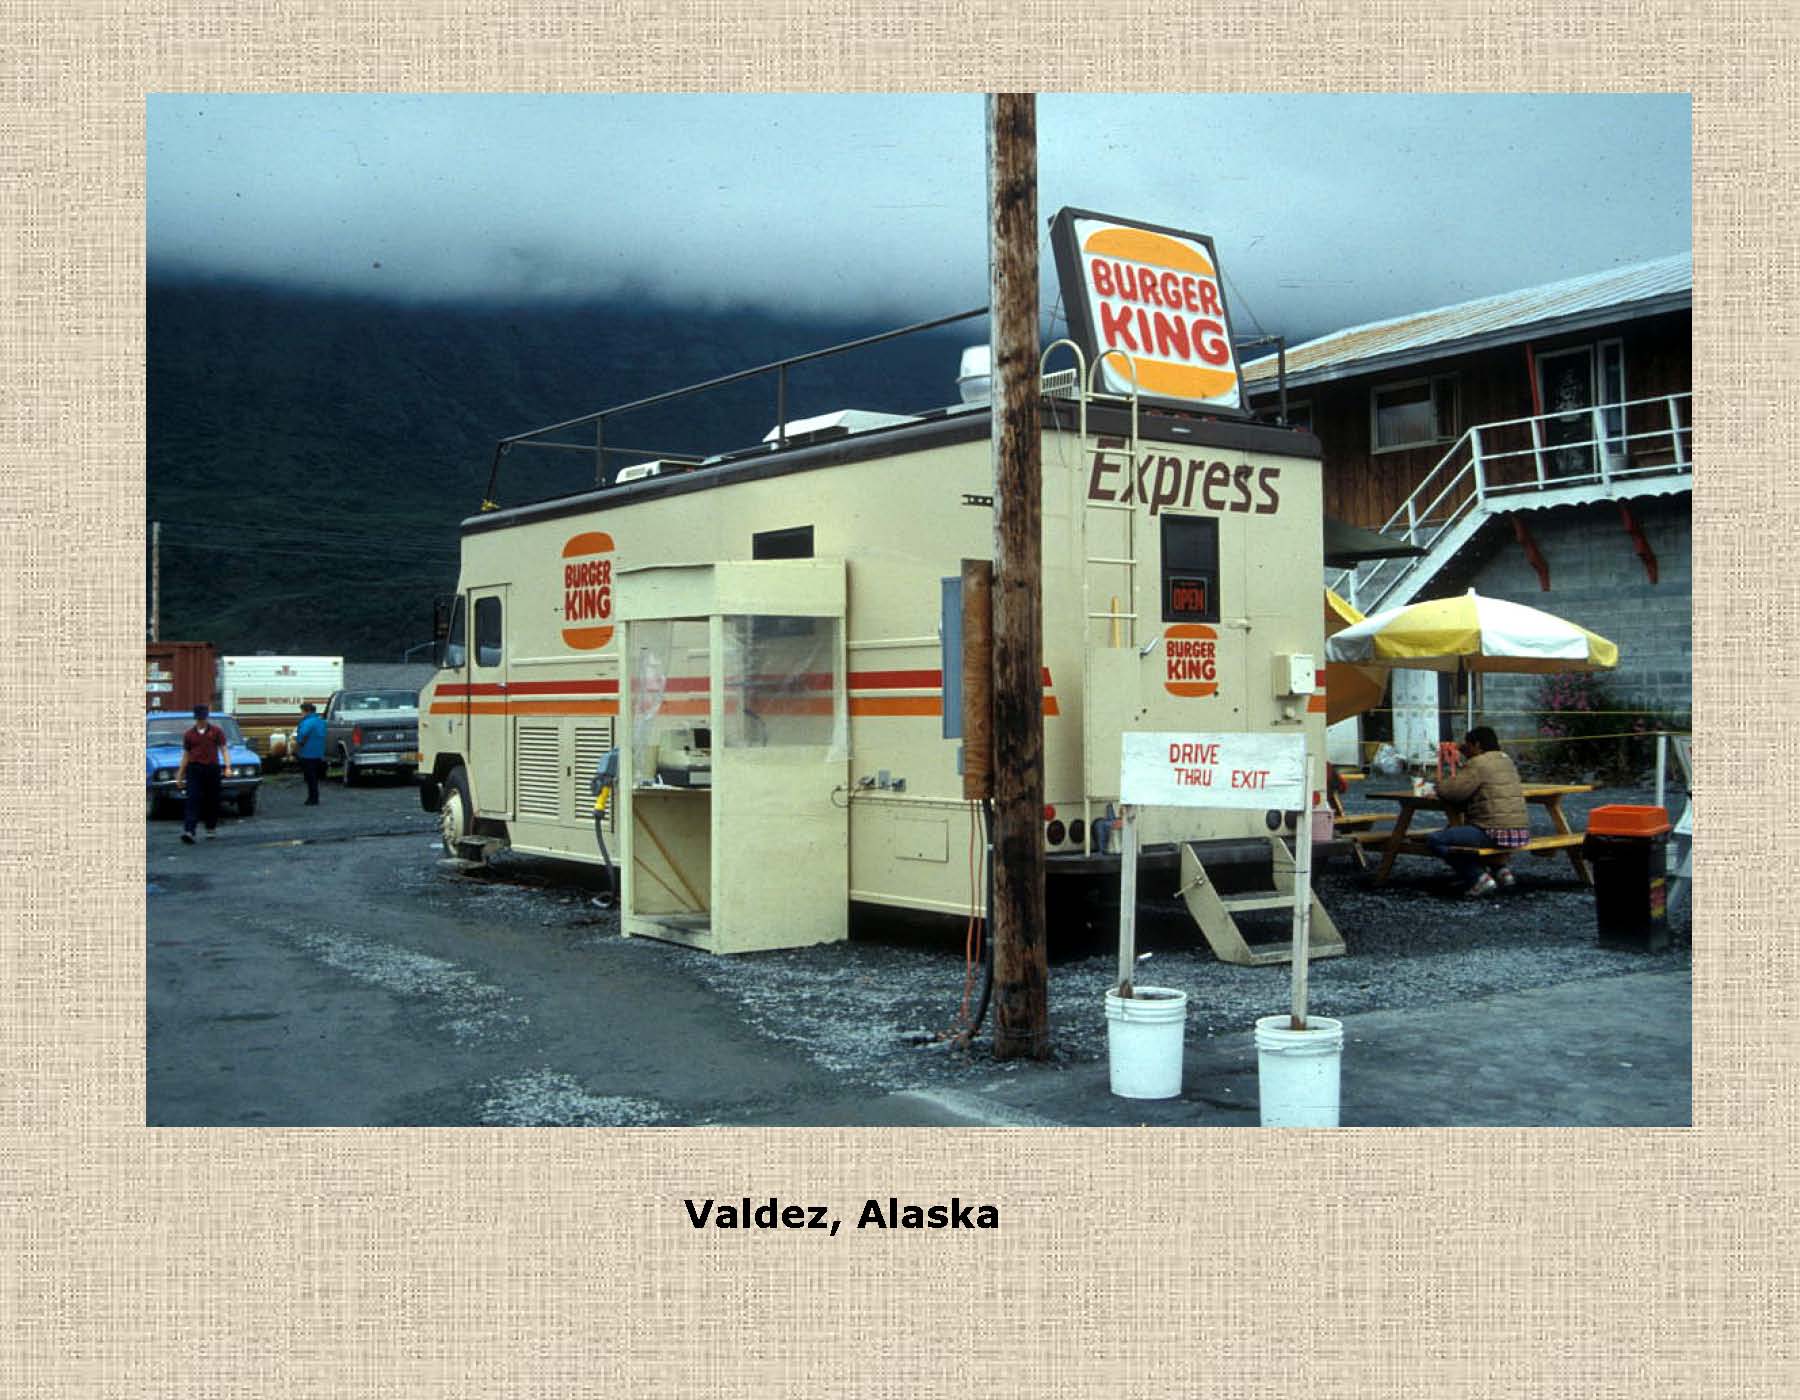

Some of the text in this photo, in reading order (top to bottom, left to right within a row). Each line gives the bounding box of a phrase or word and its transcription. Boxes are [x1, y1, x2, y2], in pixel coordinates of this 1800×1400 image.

[1091, 259, 1223, 316] BURGER
[1101, 302, 1229, 365] KING
[1087, 438, 1281, 516] Express
[564, 560, 612, 588] BURGER
[565, 587, 612, 621] KING
[1173, 588, 1204, 610] OPEN
[1166, 640, 1216, 658] BURGER
[1167, 659, 1216, 681] KING
[1169, 743, 1220, 765] DRIVE
[1174, 768, 1270, 790] THRU EXIT
